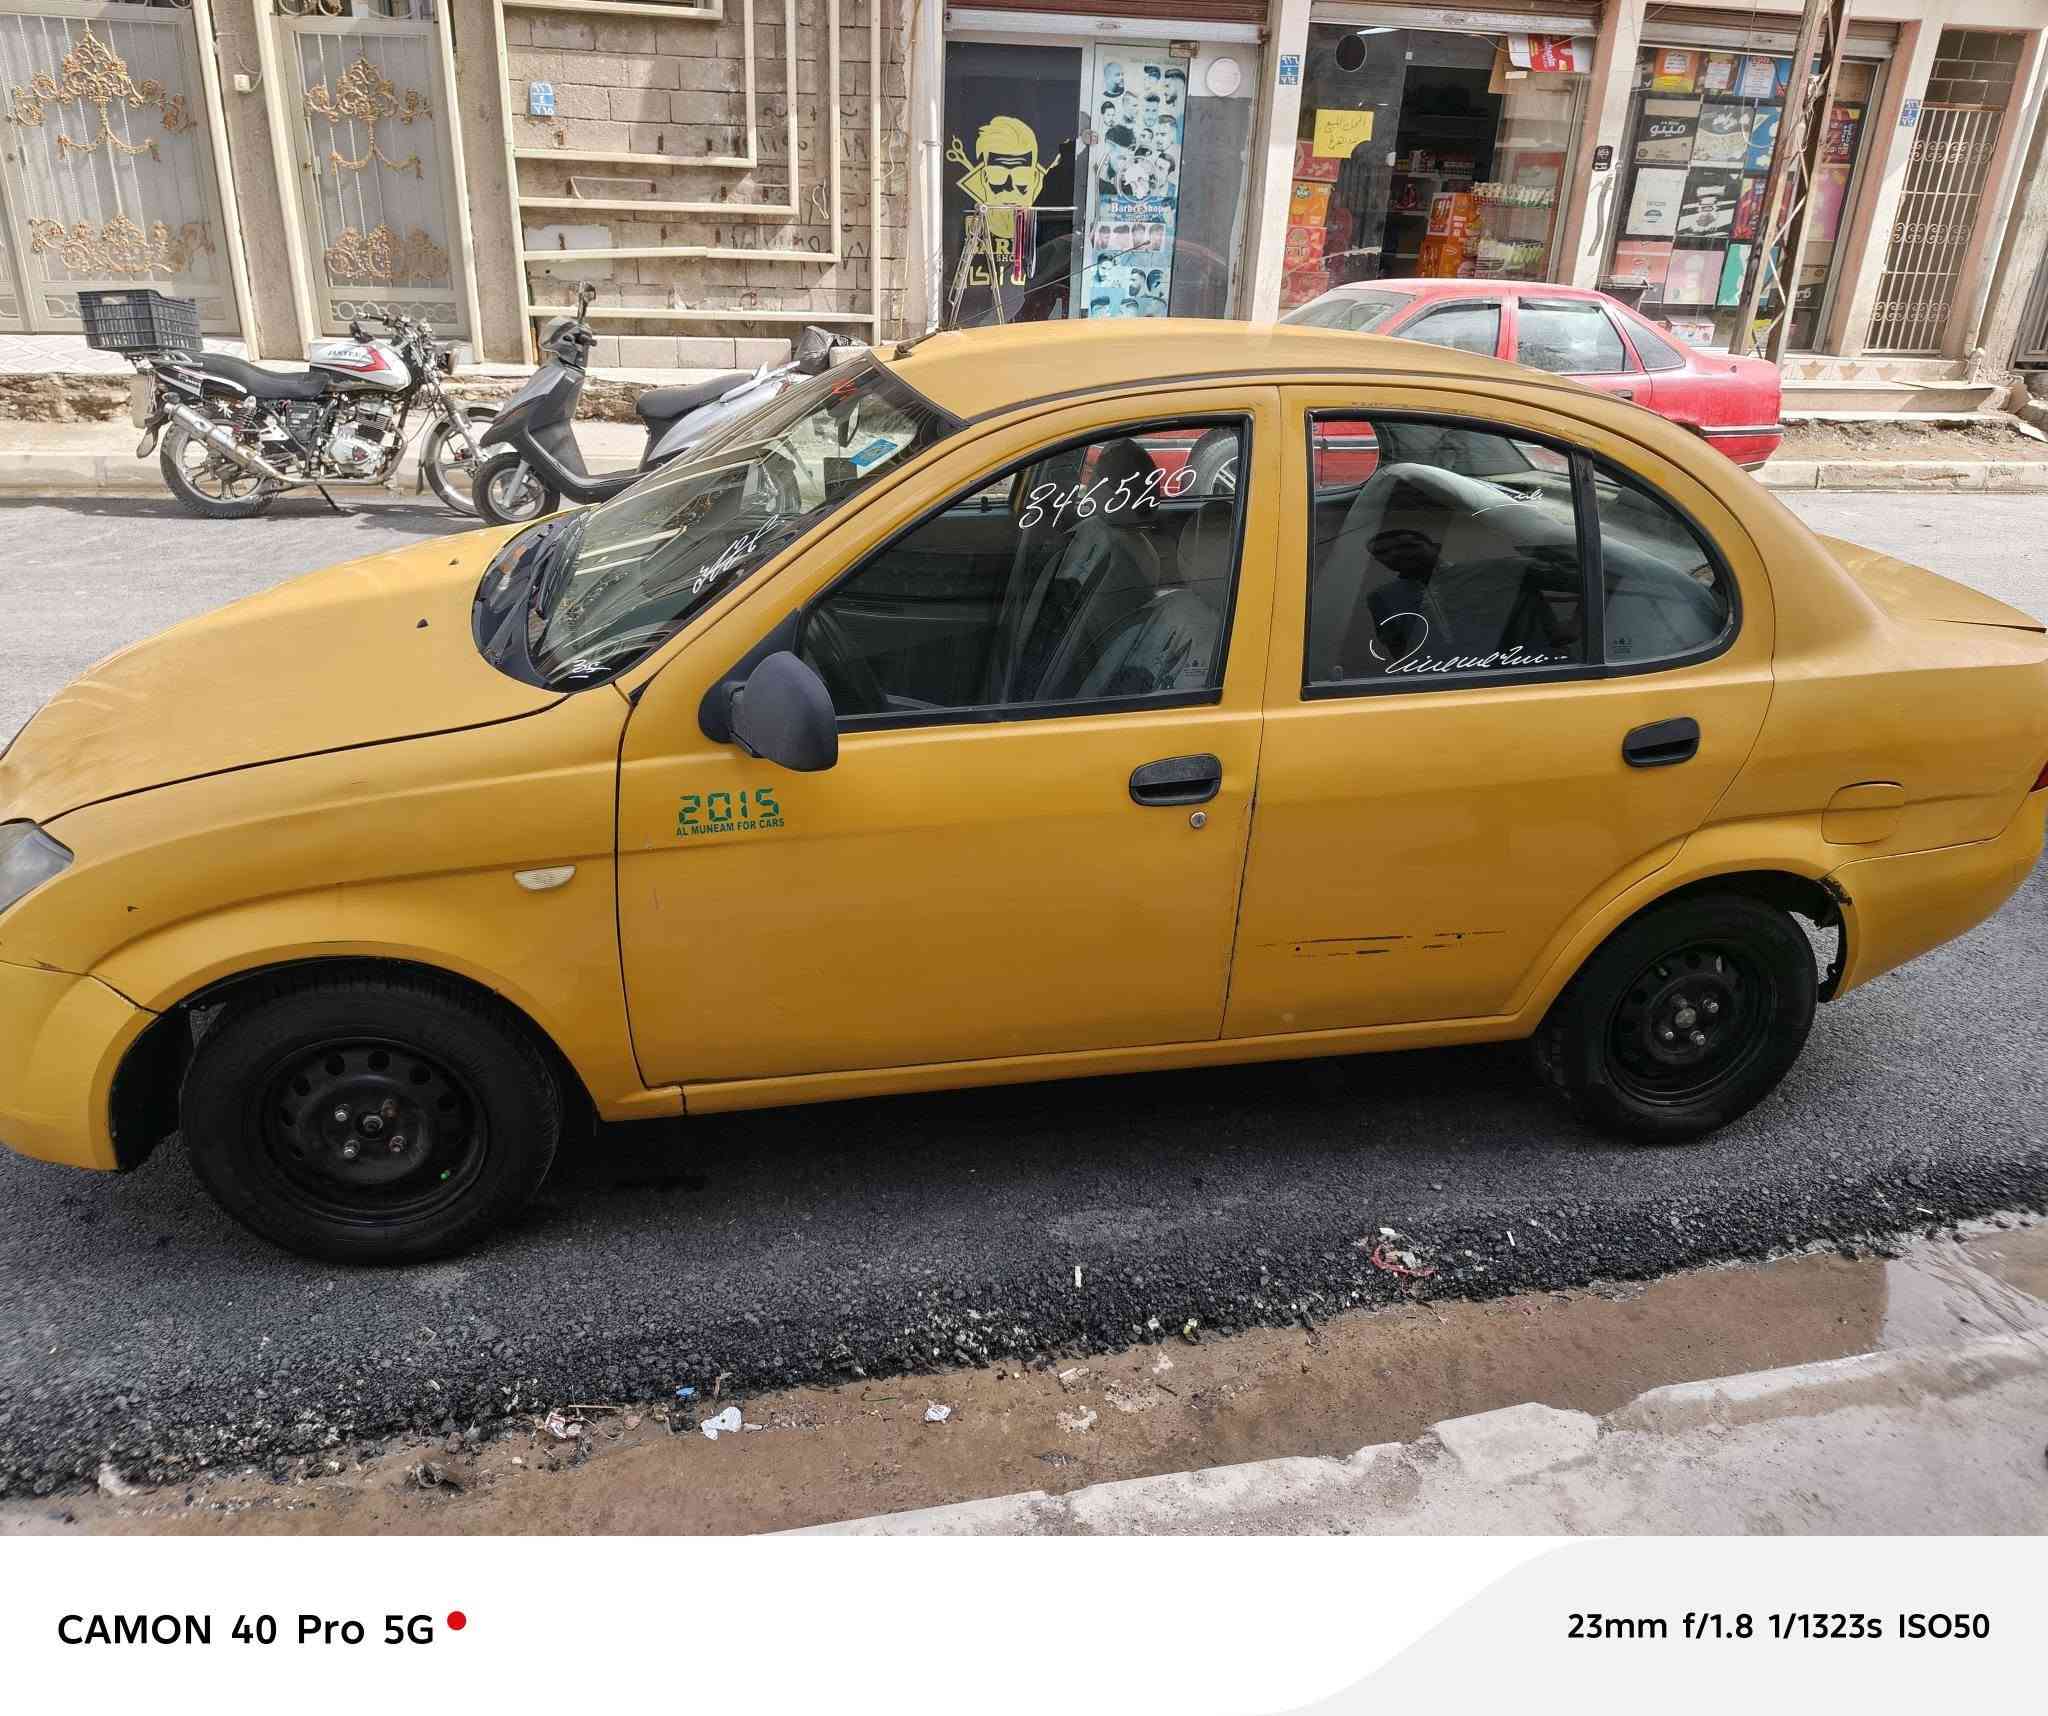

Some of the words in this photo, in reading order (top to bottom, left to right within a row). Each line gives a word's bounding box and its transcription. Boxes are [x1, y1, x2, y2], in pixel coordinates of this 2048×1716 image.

[678, 788, 780, 825] 2015
[676, 826, 689, 837] AL
[691, 822, 734, 835] MUNEAM
[737, 820, 757, 831] FOR
[759, 818, 784, 829] CARS
